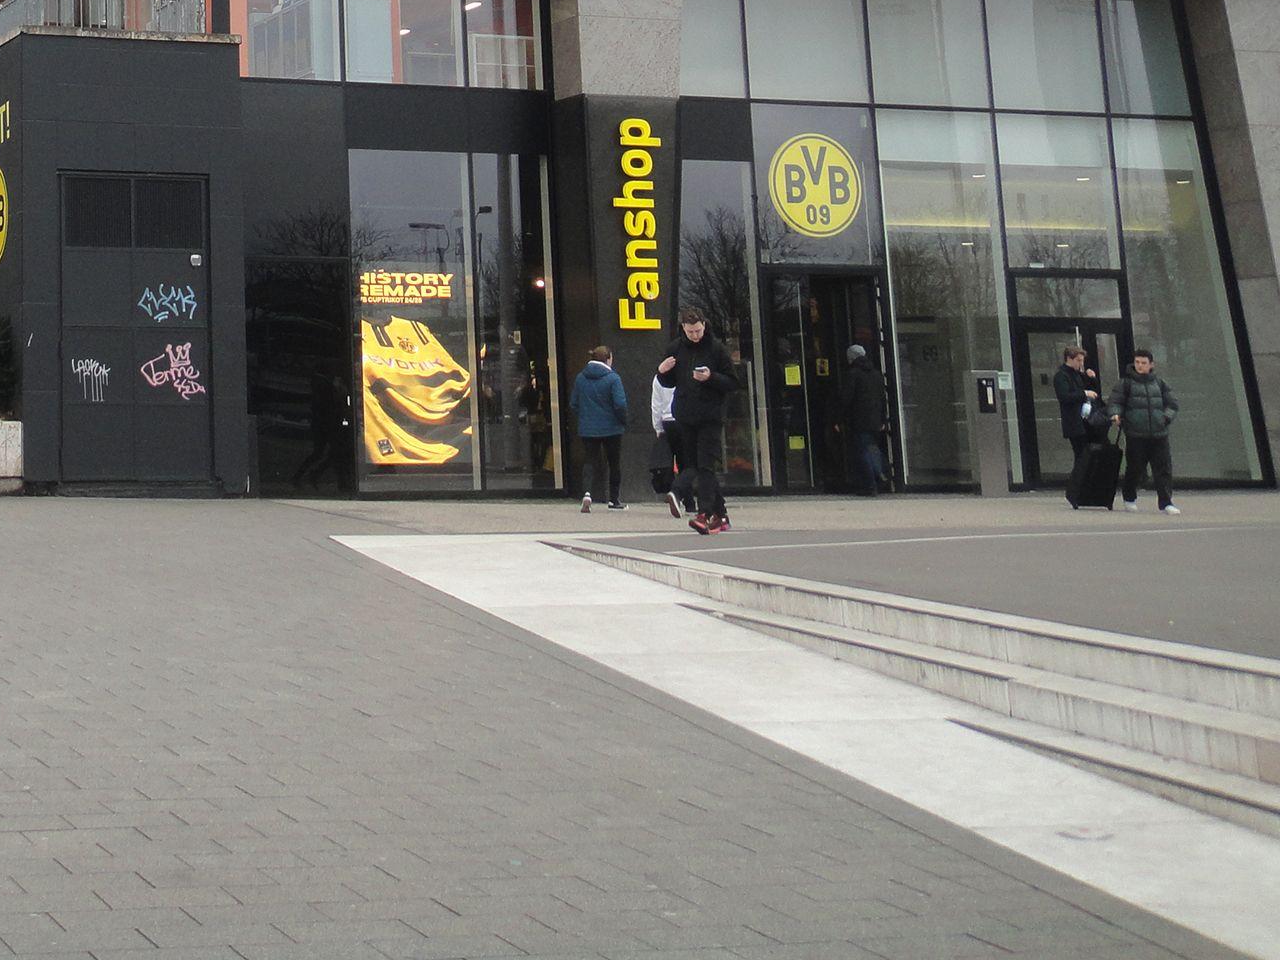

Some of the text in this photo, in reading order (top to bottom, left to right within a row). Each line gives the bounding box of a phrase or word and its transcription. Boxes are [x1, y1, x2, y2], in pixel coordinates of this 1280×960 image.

[784, 145, 851, 205] BVB
[613, 117, 661, 331] Fanshop
[805, 204, 831, 225] 09
[360, 272, 454, 285] HISTORY
[360, 285, 451, 298] REMADE
